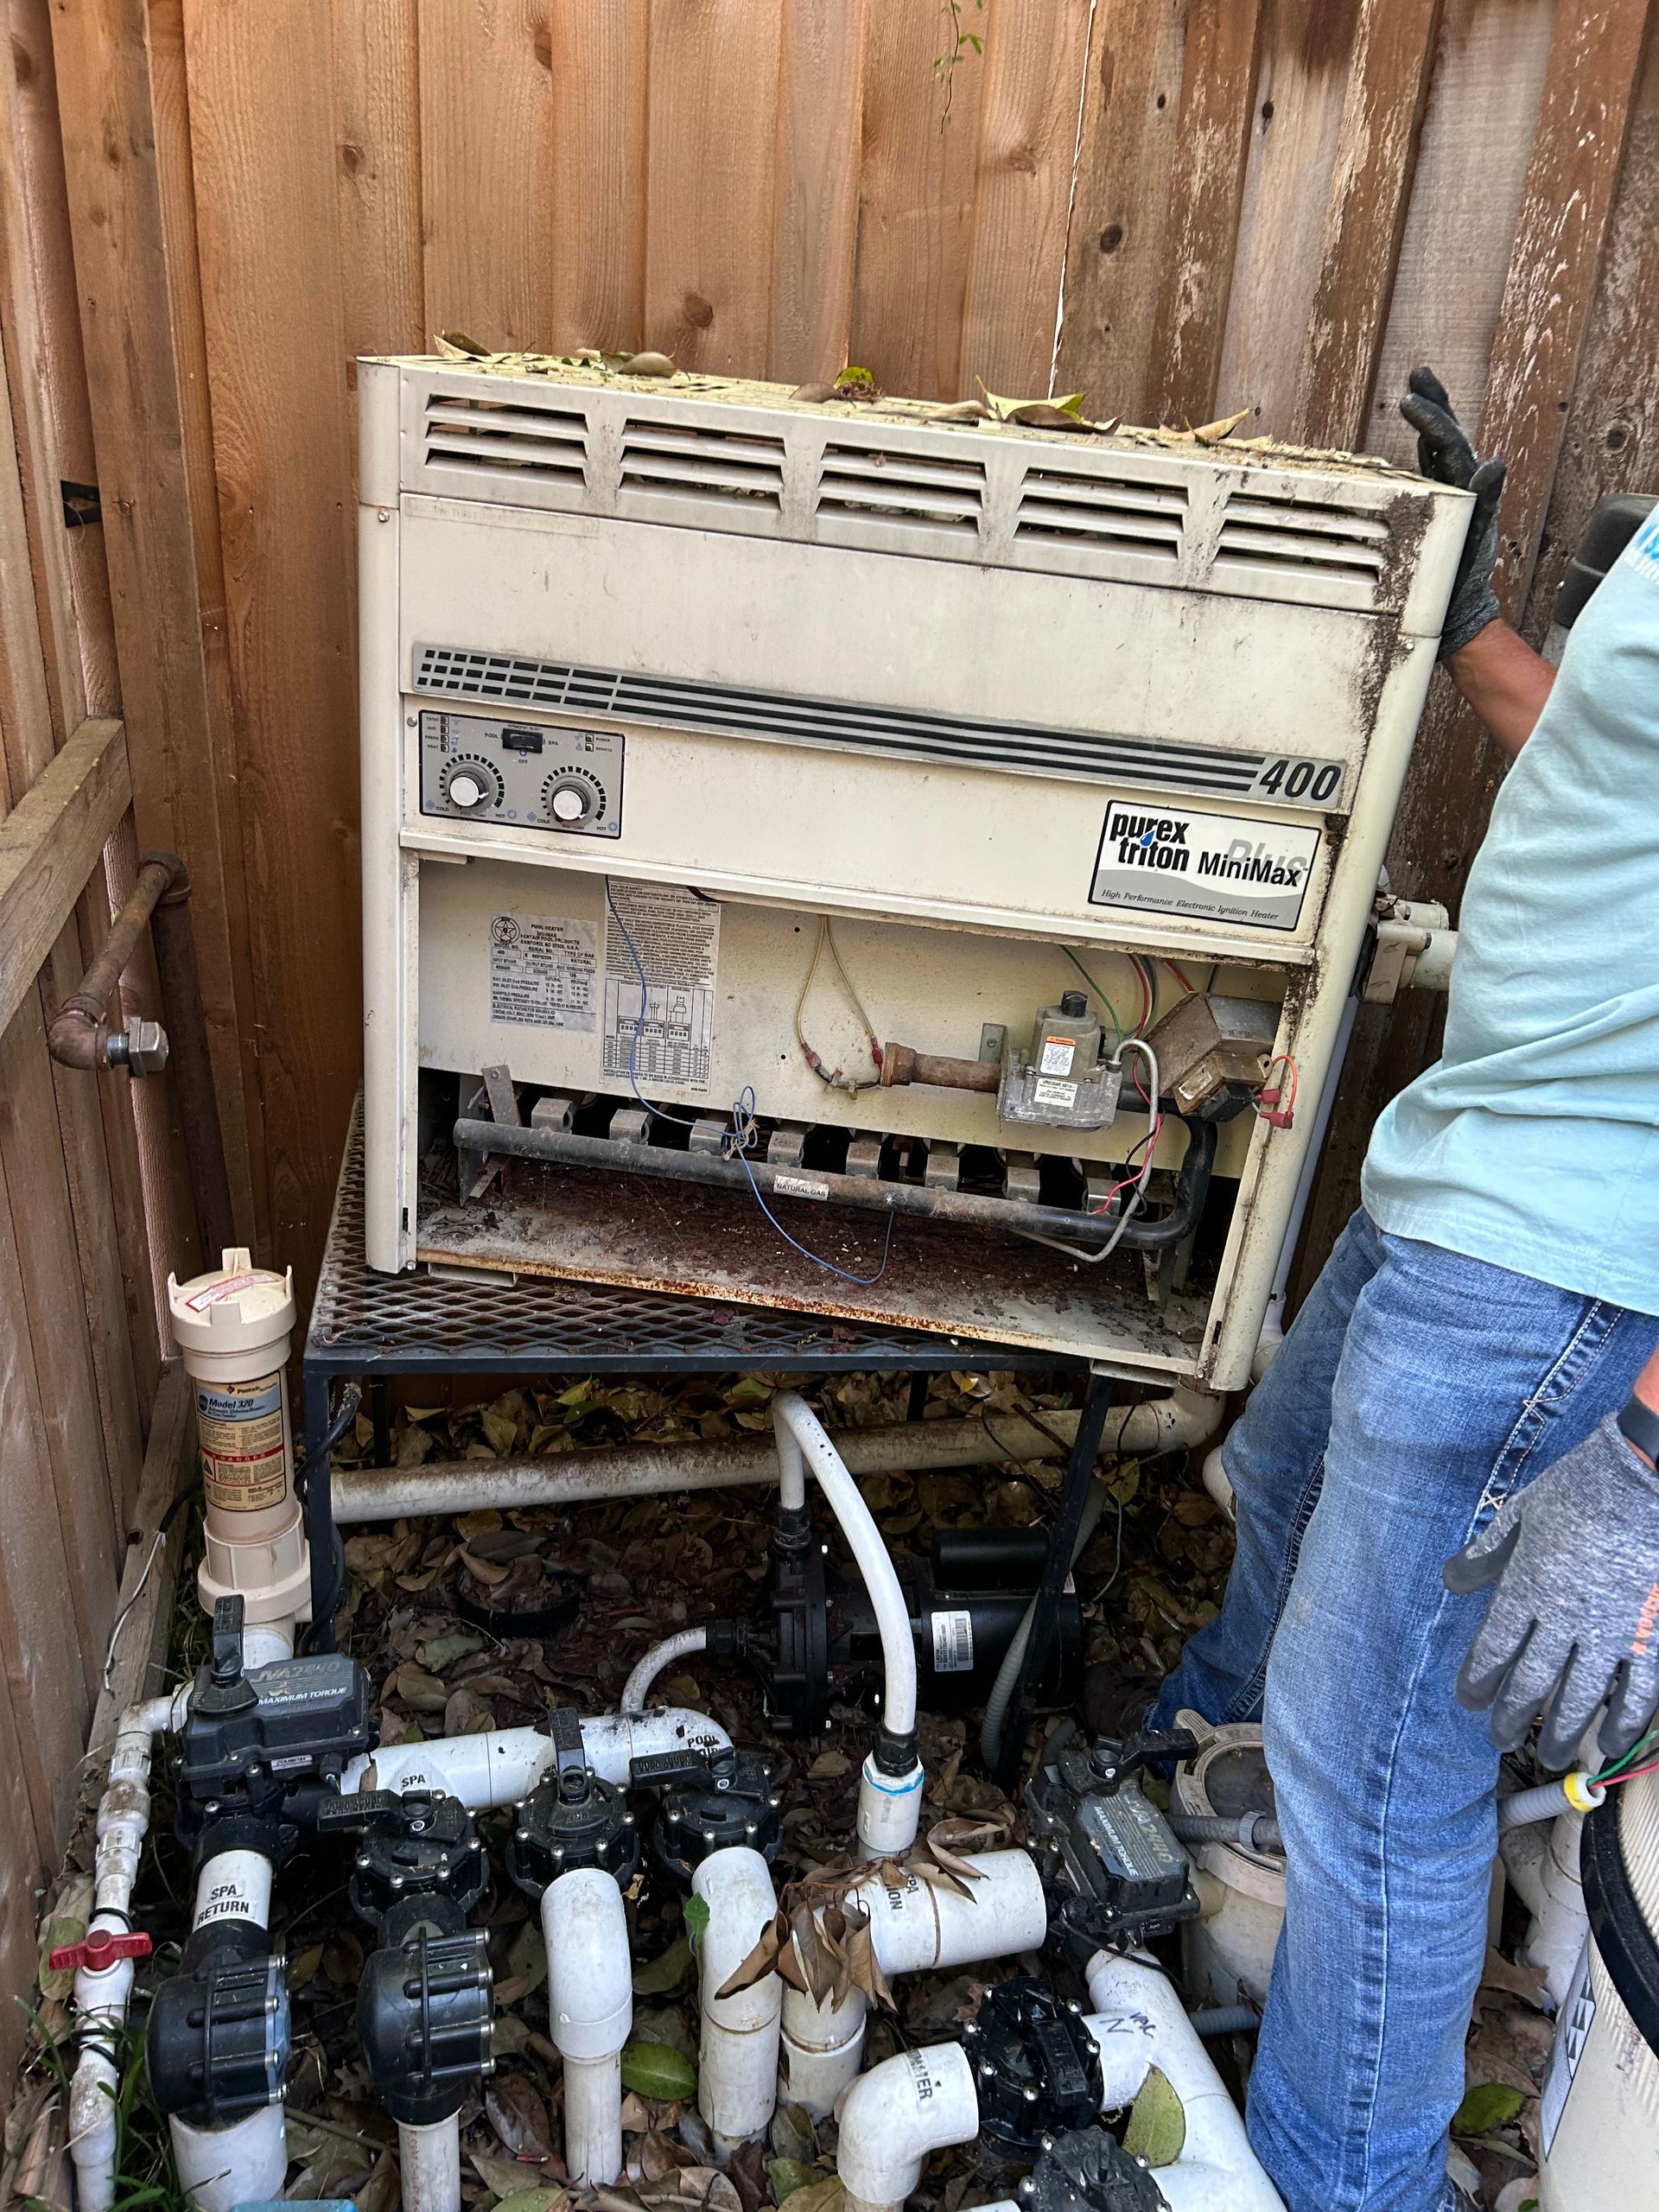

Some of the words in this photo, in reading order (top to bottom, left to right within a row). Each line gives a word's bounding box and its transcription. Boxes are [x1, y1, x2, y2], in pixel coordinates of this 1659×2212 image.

[1259, 760, 1342, 801] 400
[1109, 813, 1190, 844] purex
[1118, 836, 1190, 872] triton
[1101, 889, 1122, 899] High
[1123, 892, 1174, 906] Performance
[1176, 899, 1216, 912] Electronic
[1217, 905, 1248, 917] Ignition
[1250, 909, 1280, 920] Heater
[776, 1183, 810, 1194] NATURAL
[208, 1398, 236, 1409] Model
[237, 1399, 253, 1408] 320
[257, 1692, 308, 1706] MAXIMUM
[309, 1687, 347, 1699] TORQUE
[402, 1774, 426, 1788] SPA
[1115, 1844, 1139, 1876] TORQUE
[210, 1885, 237, 1901] SPA
[197, 1900, 250, 1926] RETURN
